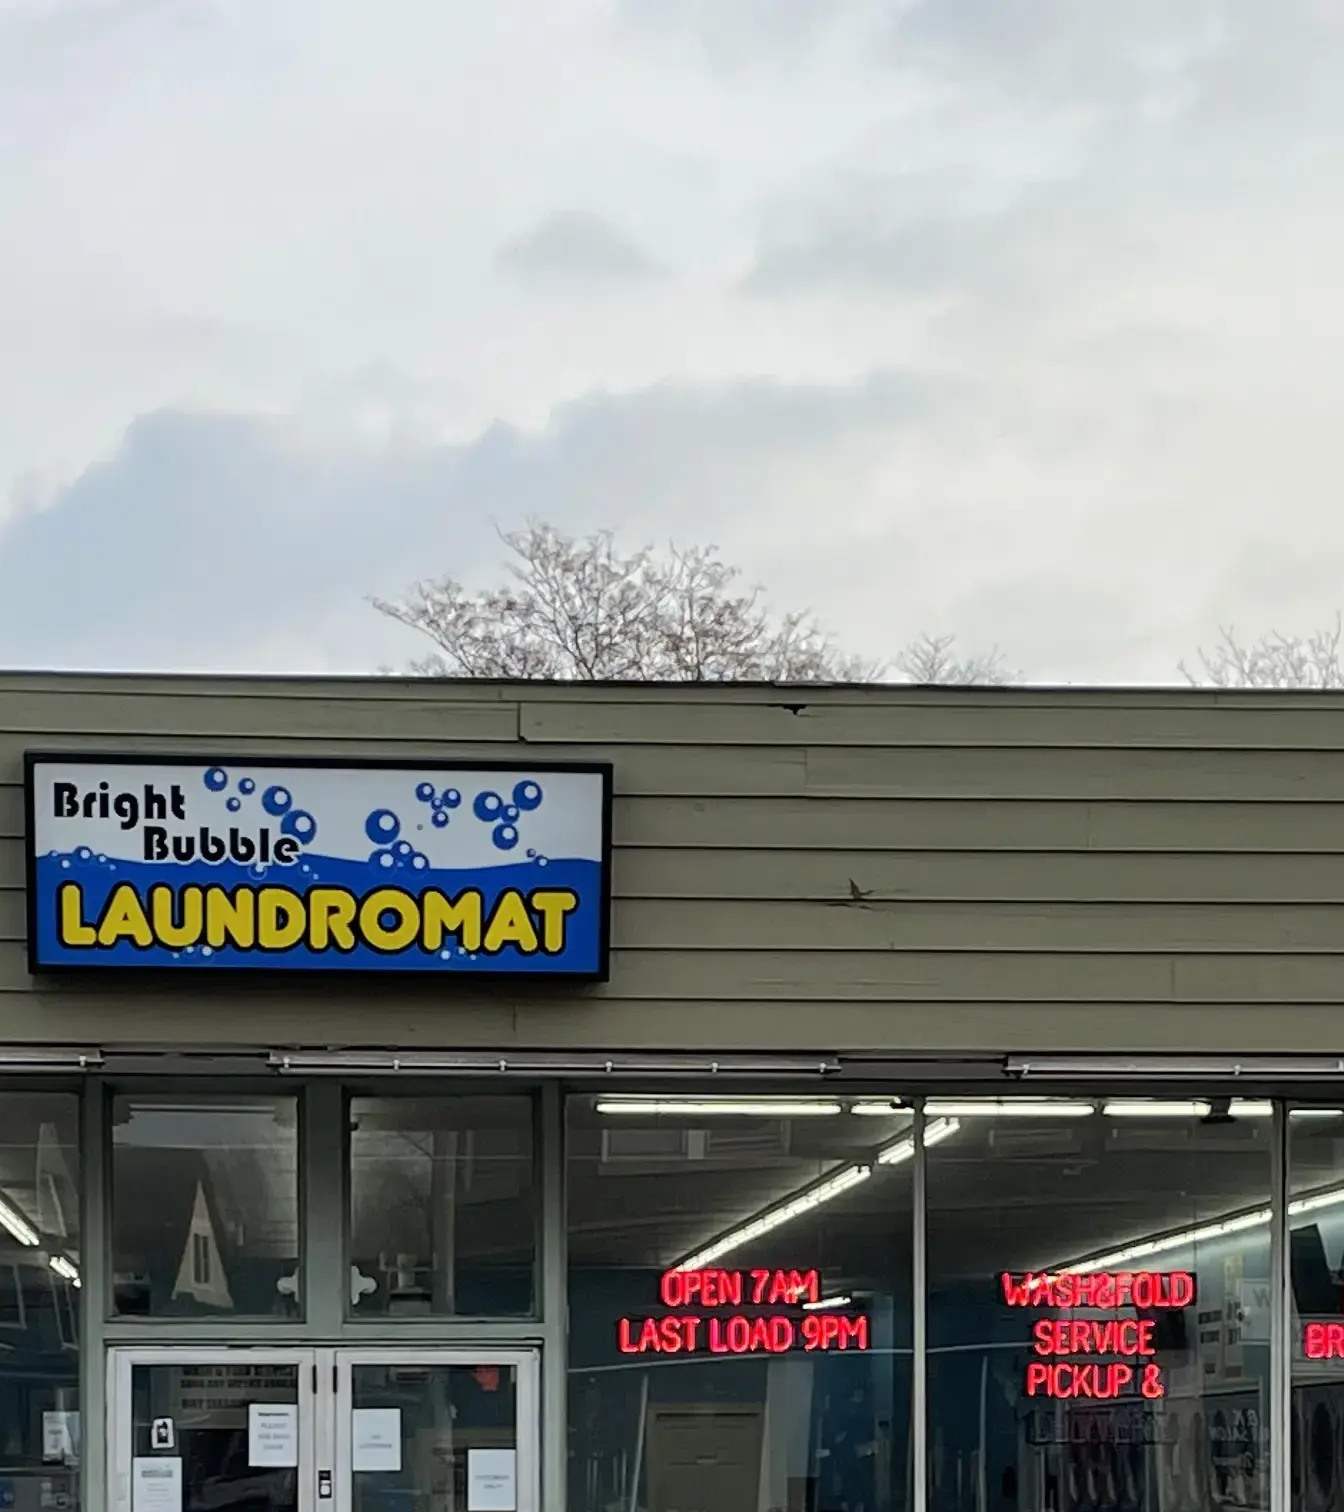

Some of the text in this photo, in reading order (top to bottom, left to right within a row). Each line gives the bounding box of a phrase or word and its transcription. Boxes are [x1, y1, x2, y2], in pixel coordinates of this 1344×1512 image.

[54, 782, 186, 830] Bright
[144, 828, 301, 866] Bubble
[59, 883, 578, 955] LAUNDROMAT
[660, 1269, 819, 1306] OPEN 7AM
[618, 1315, 868, 1353] LAST LOAD 9PM
[1032, 1319, 1156, 1355] SERVICE
[1027, 1362, 1165, 1398] PICKUP &
